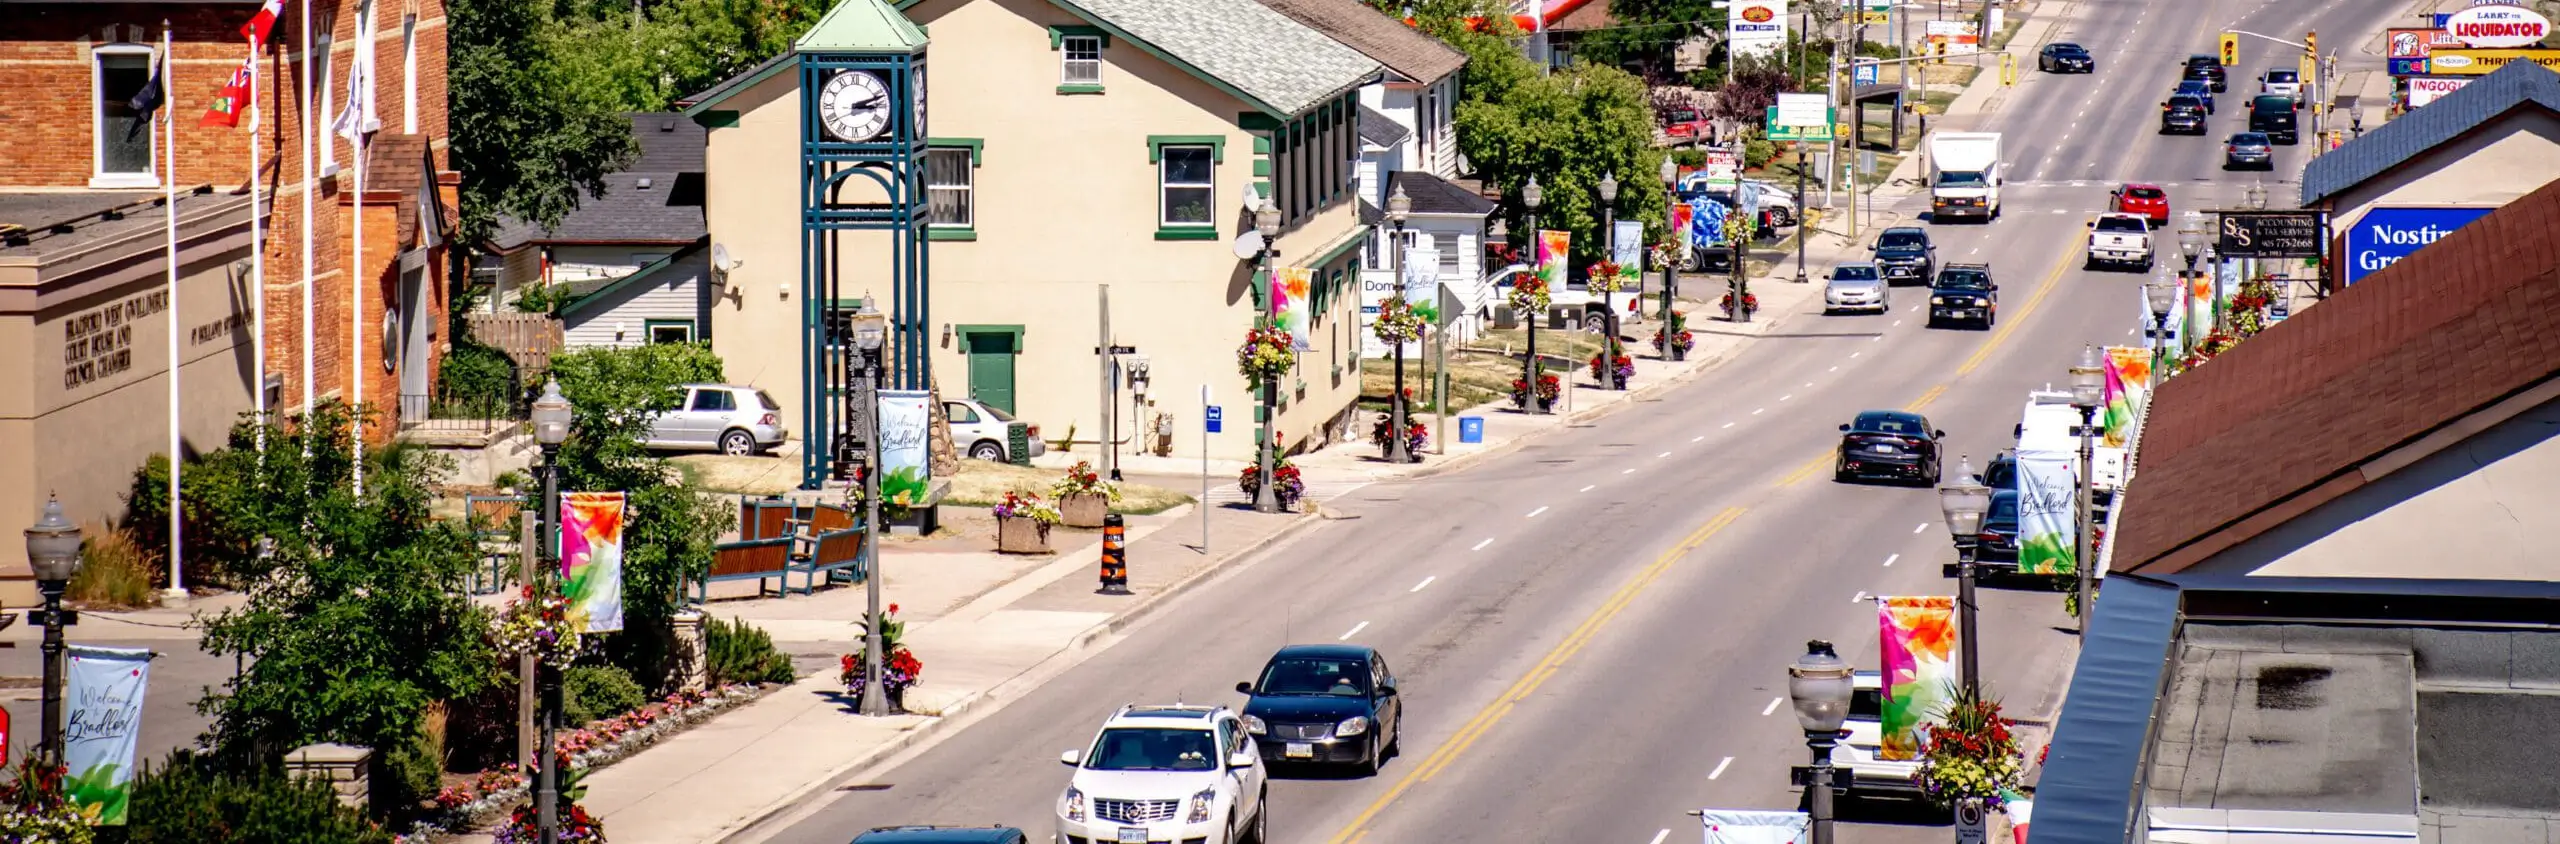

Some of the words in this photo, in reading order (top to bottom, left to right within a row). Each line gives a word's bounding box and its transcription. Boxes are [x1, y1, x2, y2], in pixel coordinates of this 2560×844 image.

[2456, 23, 2543, 37] LIQUIDATOR
[2476, 57, 2515, 66] THRIF
[2256, 219, 2314, 227] ACCOUNTING
[2280, 228, 2314, 236] SERVICES
[2276, 238, 2313, 247] 775-2668
[116, 324, 131, 348] AND
[881, 428, 925, 452] Bradford
[2020, 491, 2073, 517] Bradford
[66, 706, 137, 742] Bradford
